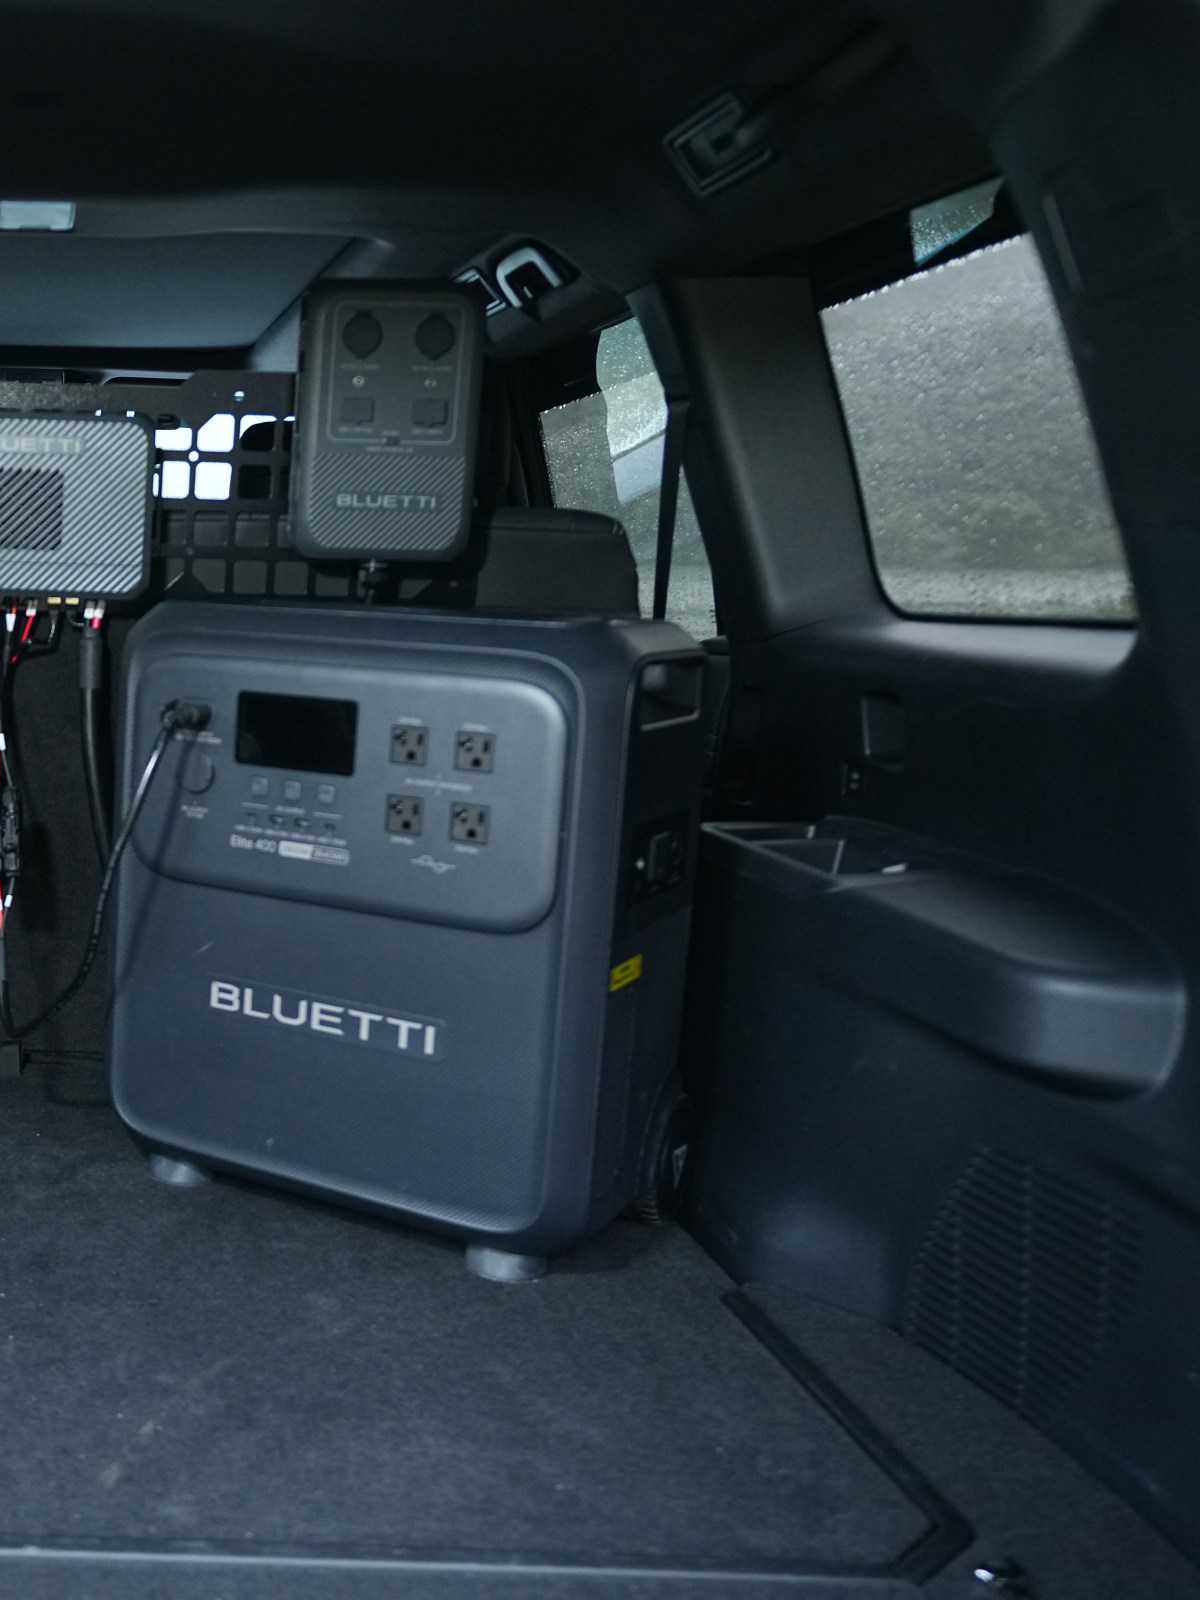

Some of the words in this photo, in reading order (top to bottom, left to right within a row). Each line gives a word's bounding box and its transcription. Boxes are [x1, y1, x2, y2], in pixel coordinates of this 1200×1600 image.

[336, 494, 436, 509] BLUETTI
[229, 834, 254, 850] Elite
[209, 981, 436, 1055] BLUETTI
